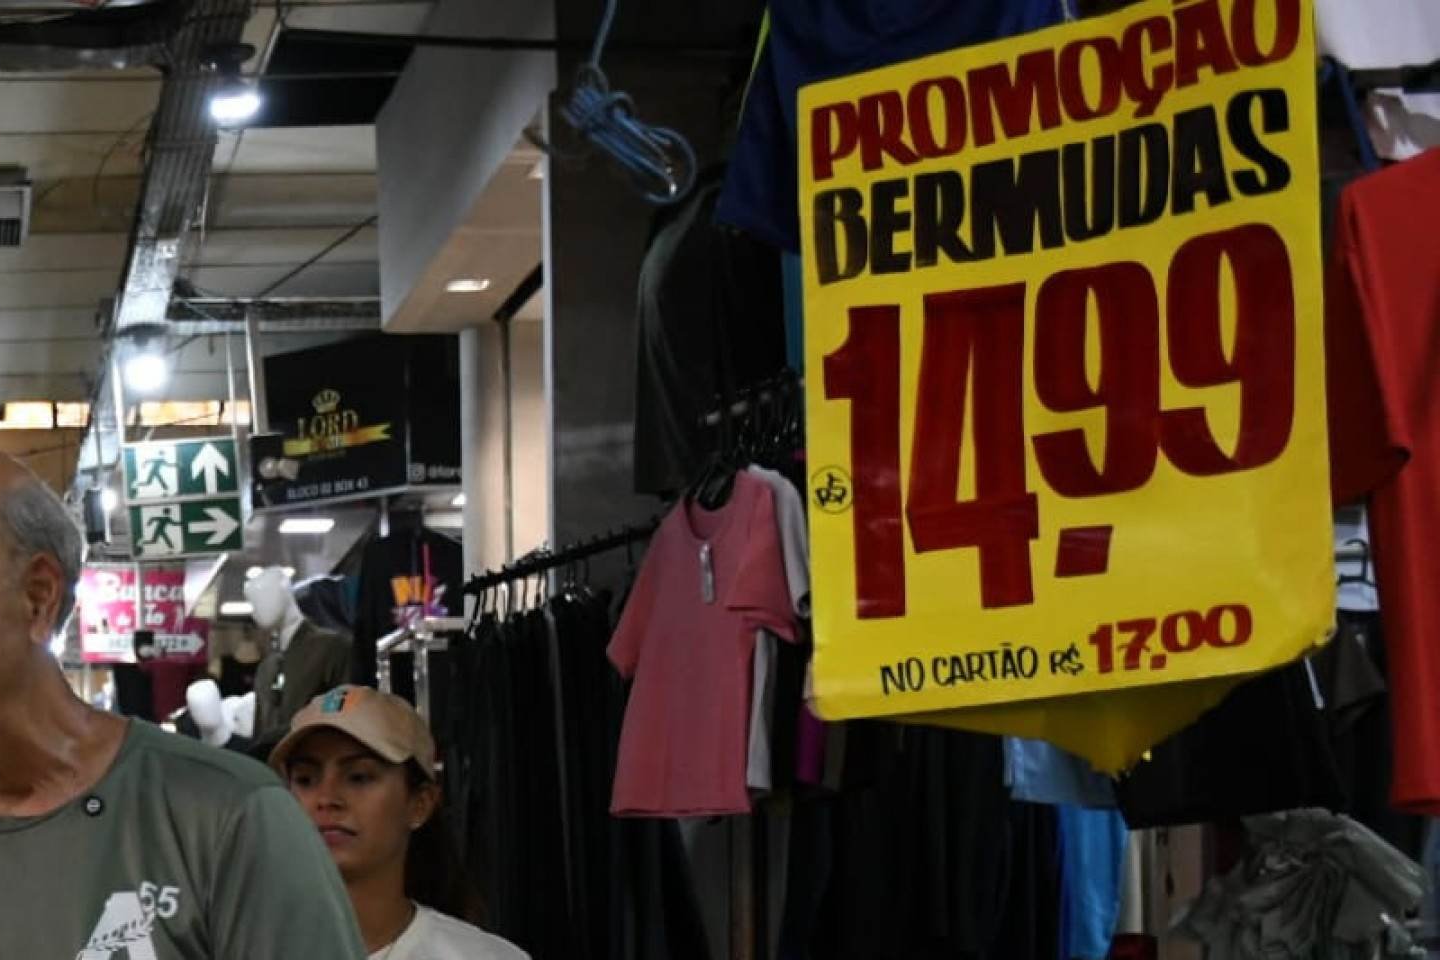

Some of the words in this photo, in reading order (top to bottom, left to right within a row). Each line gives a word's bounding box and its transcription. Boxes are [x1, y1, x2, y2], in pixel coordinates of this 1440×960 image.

[814, 88, 1292, 286] BERMUDAS
[880, 658, 924, 695] NO
[932, 642, 1039, 687] CARTÃO
[1049, 642, 1085, 676] R$
[139, 880, 180, 918] 55
